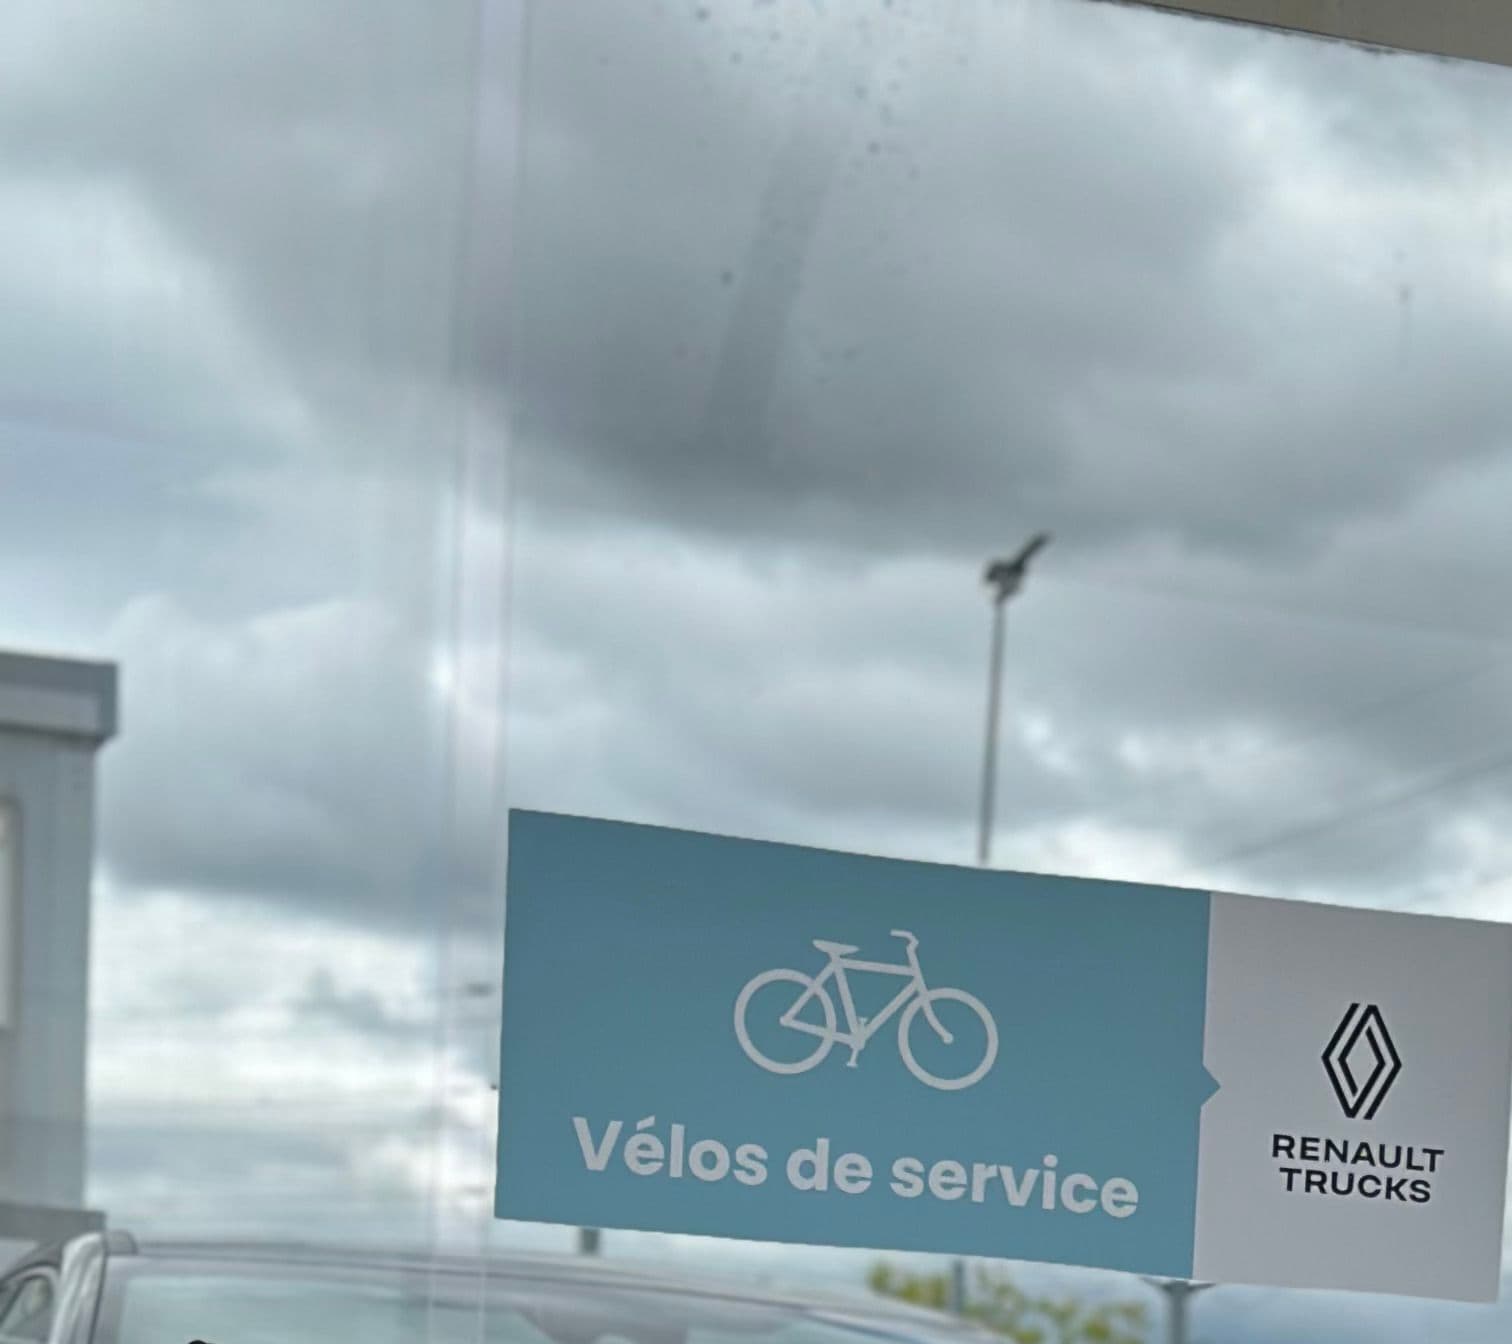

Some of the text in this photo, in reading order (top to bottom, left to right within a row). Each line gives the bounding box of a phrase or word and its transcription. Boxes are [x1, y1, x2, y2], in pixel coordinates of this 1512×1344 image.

[573, 1115, 1139, 1218] Vélos de service
[1272, 1133, 1445, 1173] RENAULT
[1279, 1167, 1431, 1204] TRUCKS
